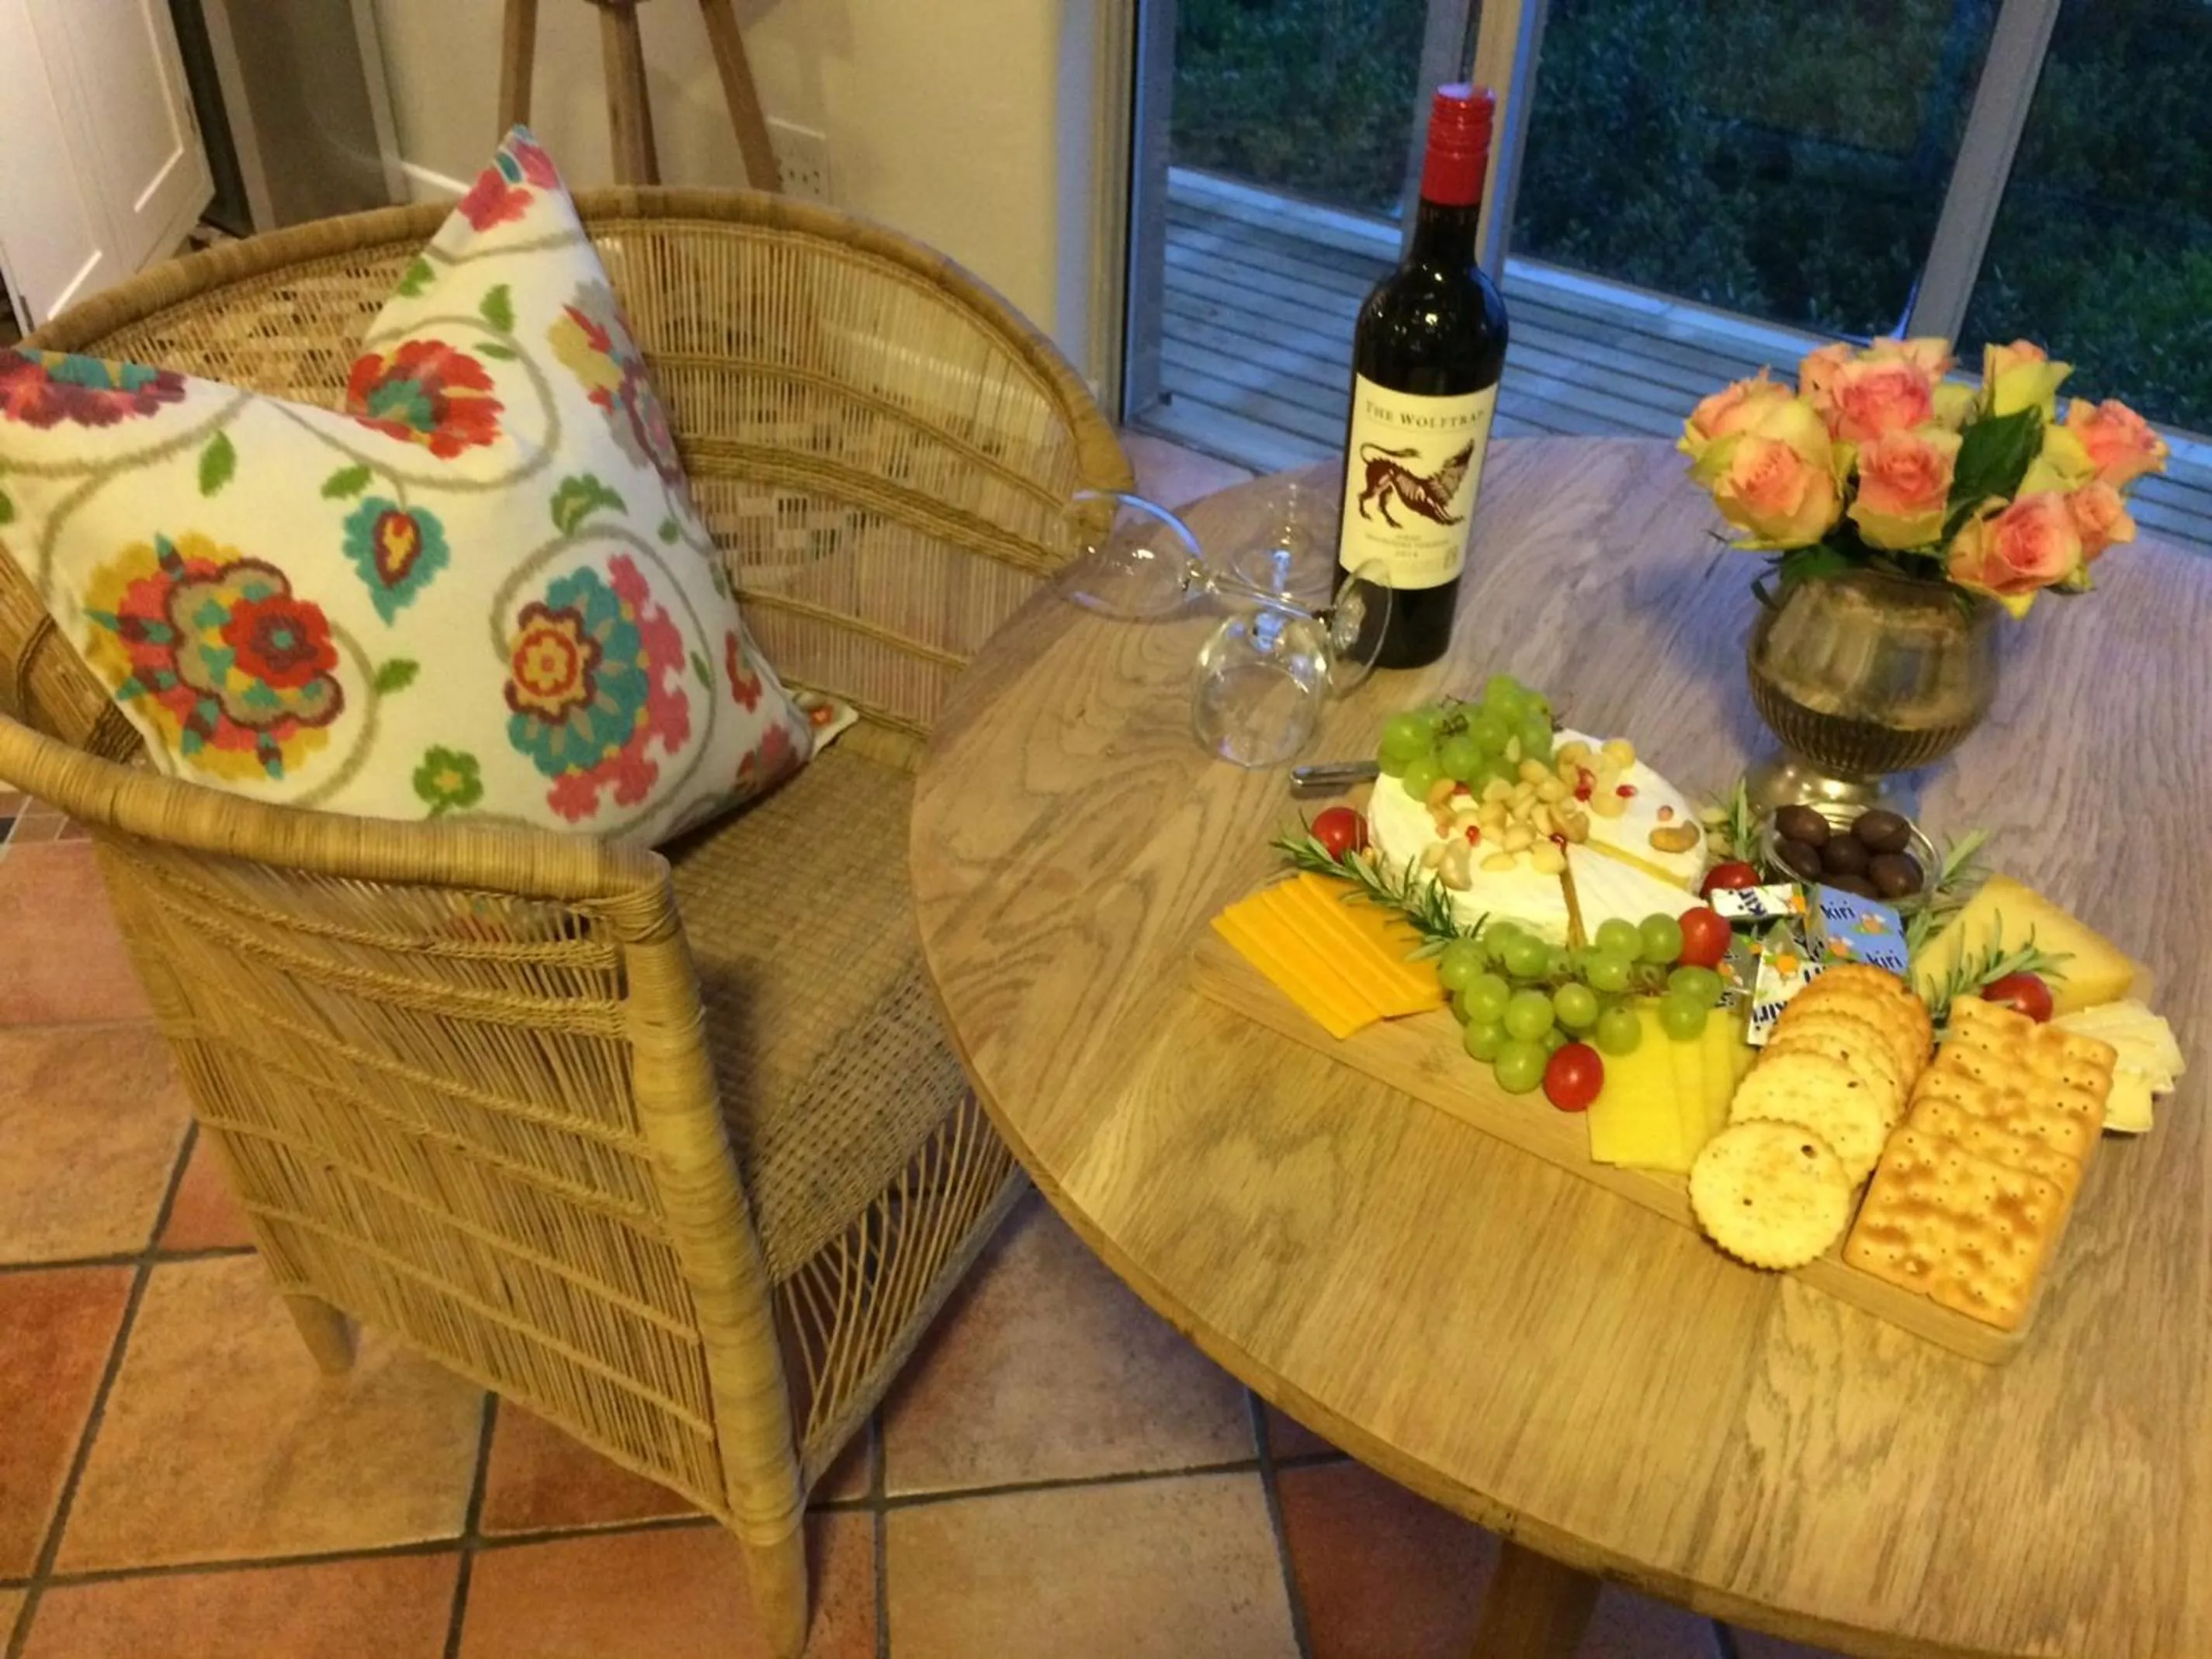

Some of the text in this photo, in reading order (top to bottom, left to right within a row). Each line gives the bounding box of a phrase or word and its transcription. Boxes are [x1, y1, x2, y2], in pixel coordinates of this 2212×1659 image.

[1366, 400, 1393, 421] THE
[1728, 889, 1767, 916] kir
[1819, 900, 1855, 920] kiri
[1865, 949, 1903, 969] kiri
